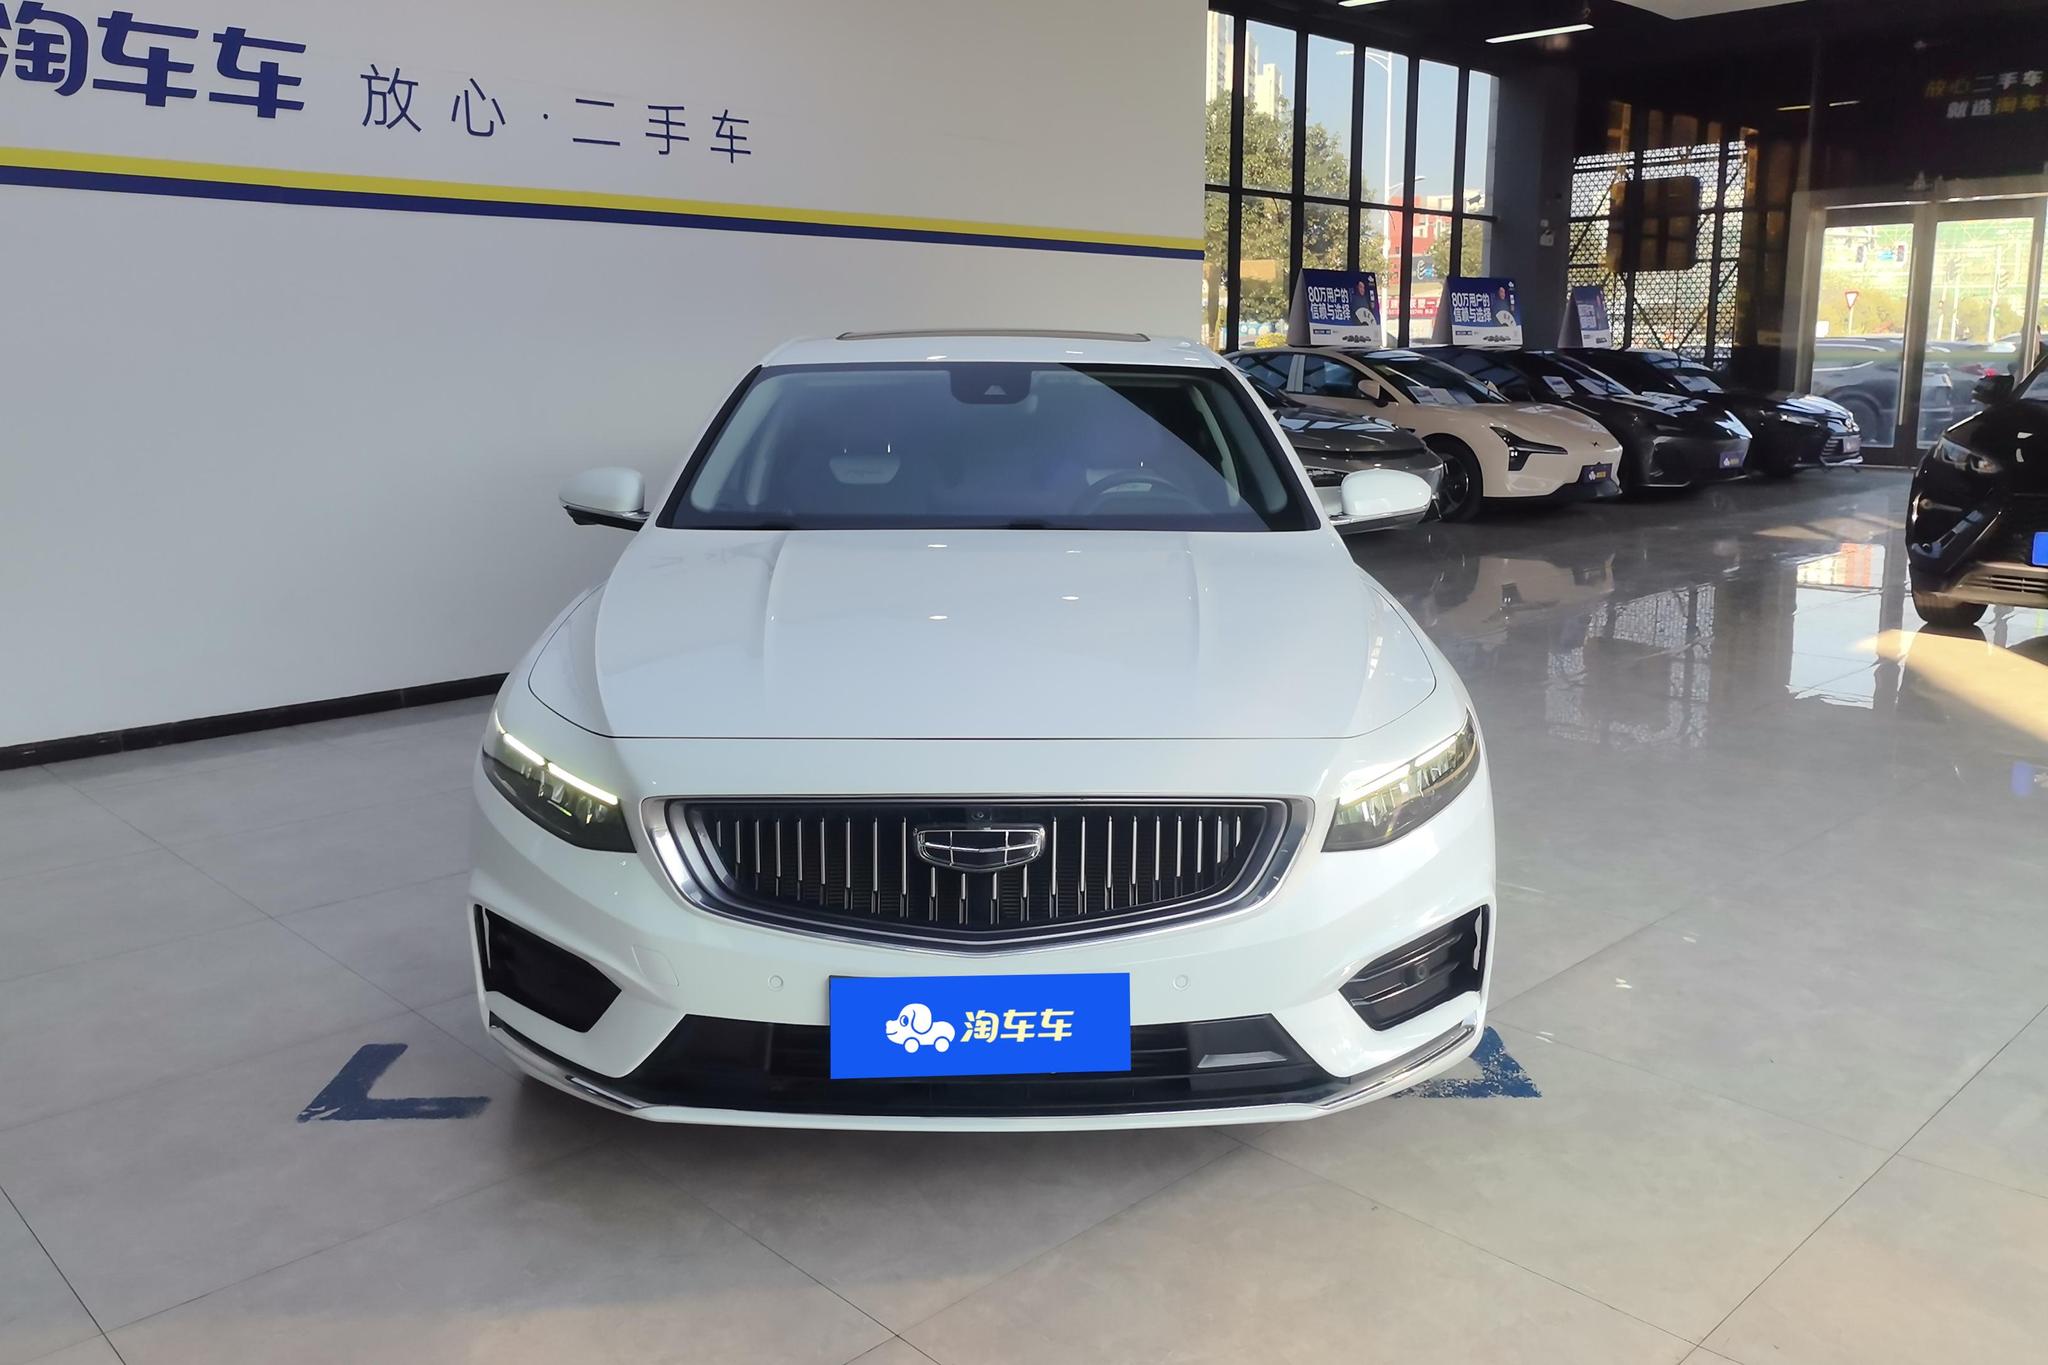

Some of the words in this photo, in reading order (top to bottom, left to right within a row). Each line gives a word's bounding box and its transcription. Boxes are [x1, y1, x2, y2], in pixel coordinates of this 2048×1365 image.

[0, 1, 306, 118] 淘车车
[1308, 286, 1349, 303] 80万用户的
[1451, 292, 1490, 307] 80万用户的
[1310, 303, 1351, 320] 信赖与选择
